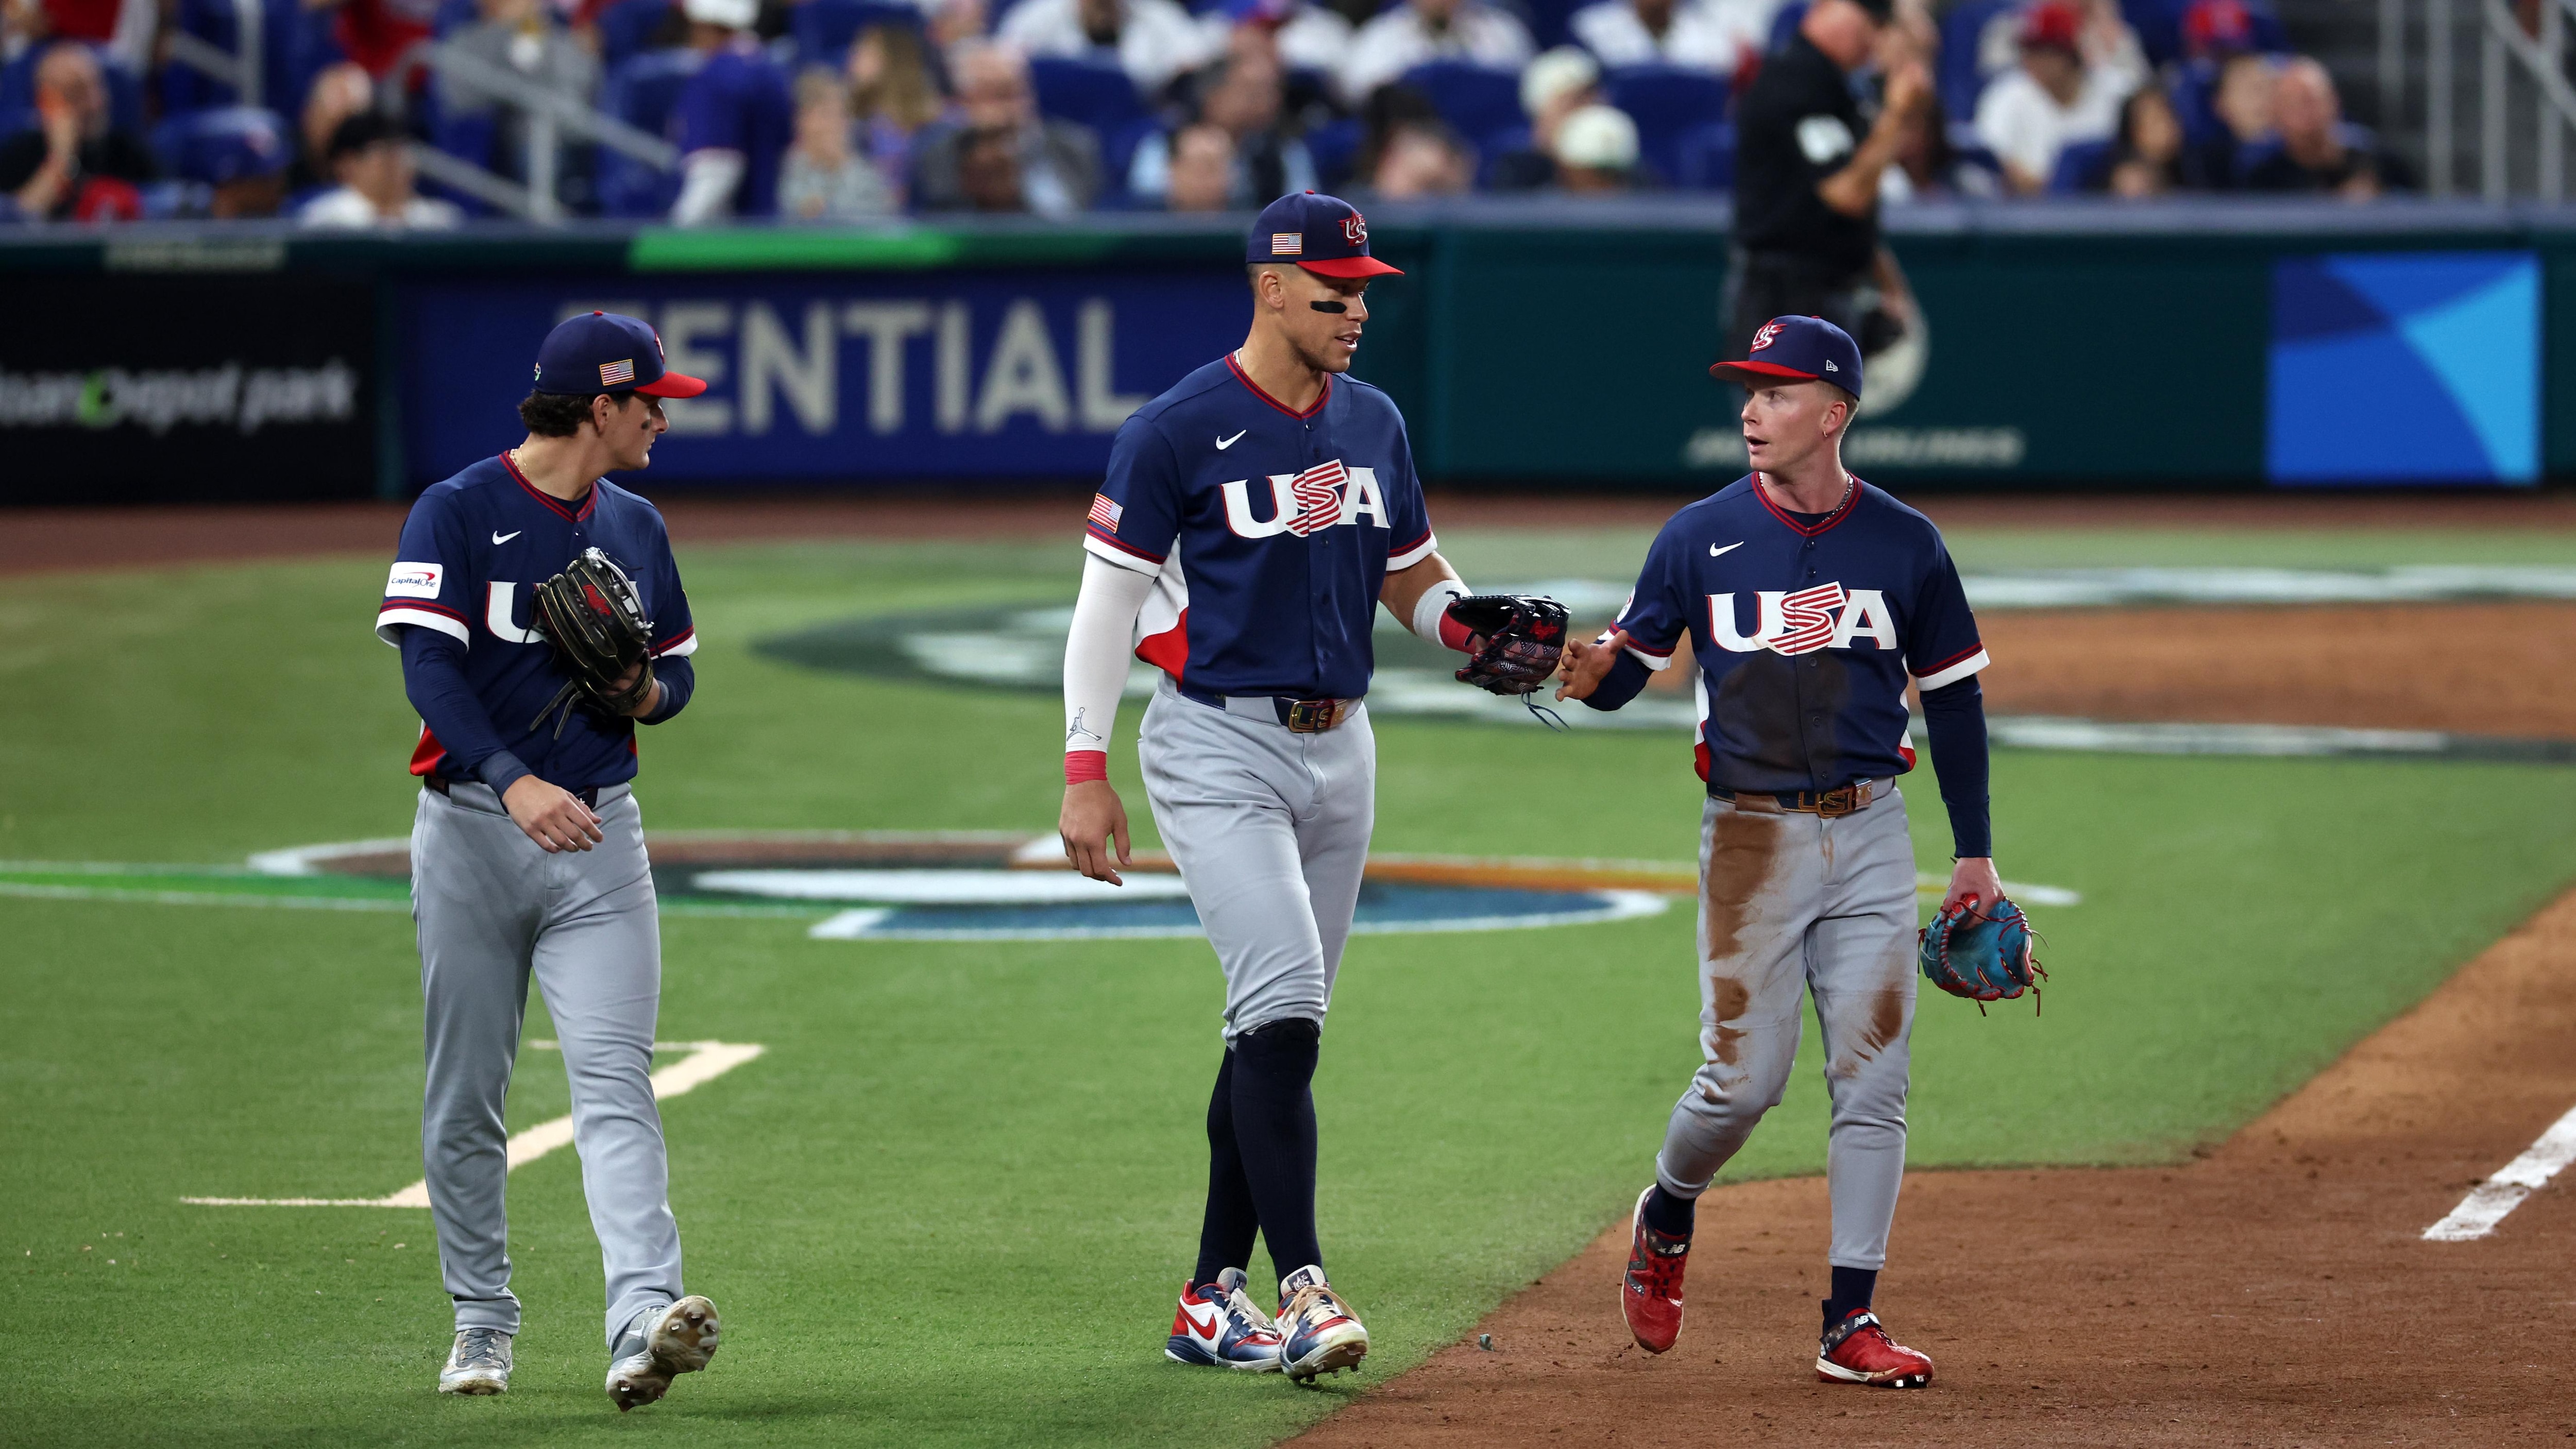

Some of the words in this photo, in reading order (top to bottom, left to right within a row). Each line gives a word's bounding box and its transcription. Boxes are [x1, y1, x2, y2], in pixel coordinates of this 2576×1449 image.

[557, 299, 1153, 432] ENTIAL
[1218, 458, 1391, 539] USA
[1705, 581, 1897, 656] USA
